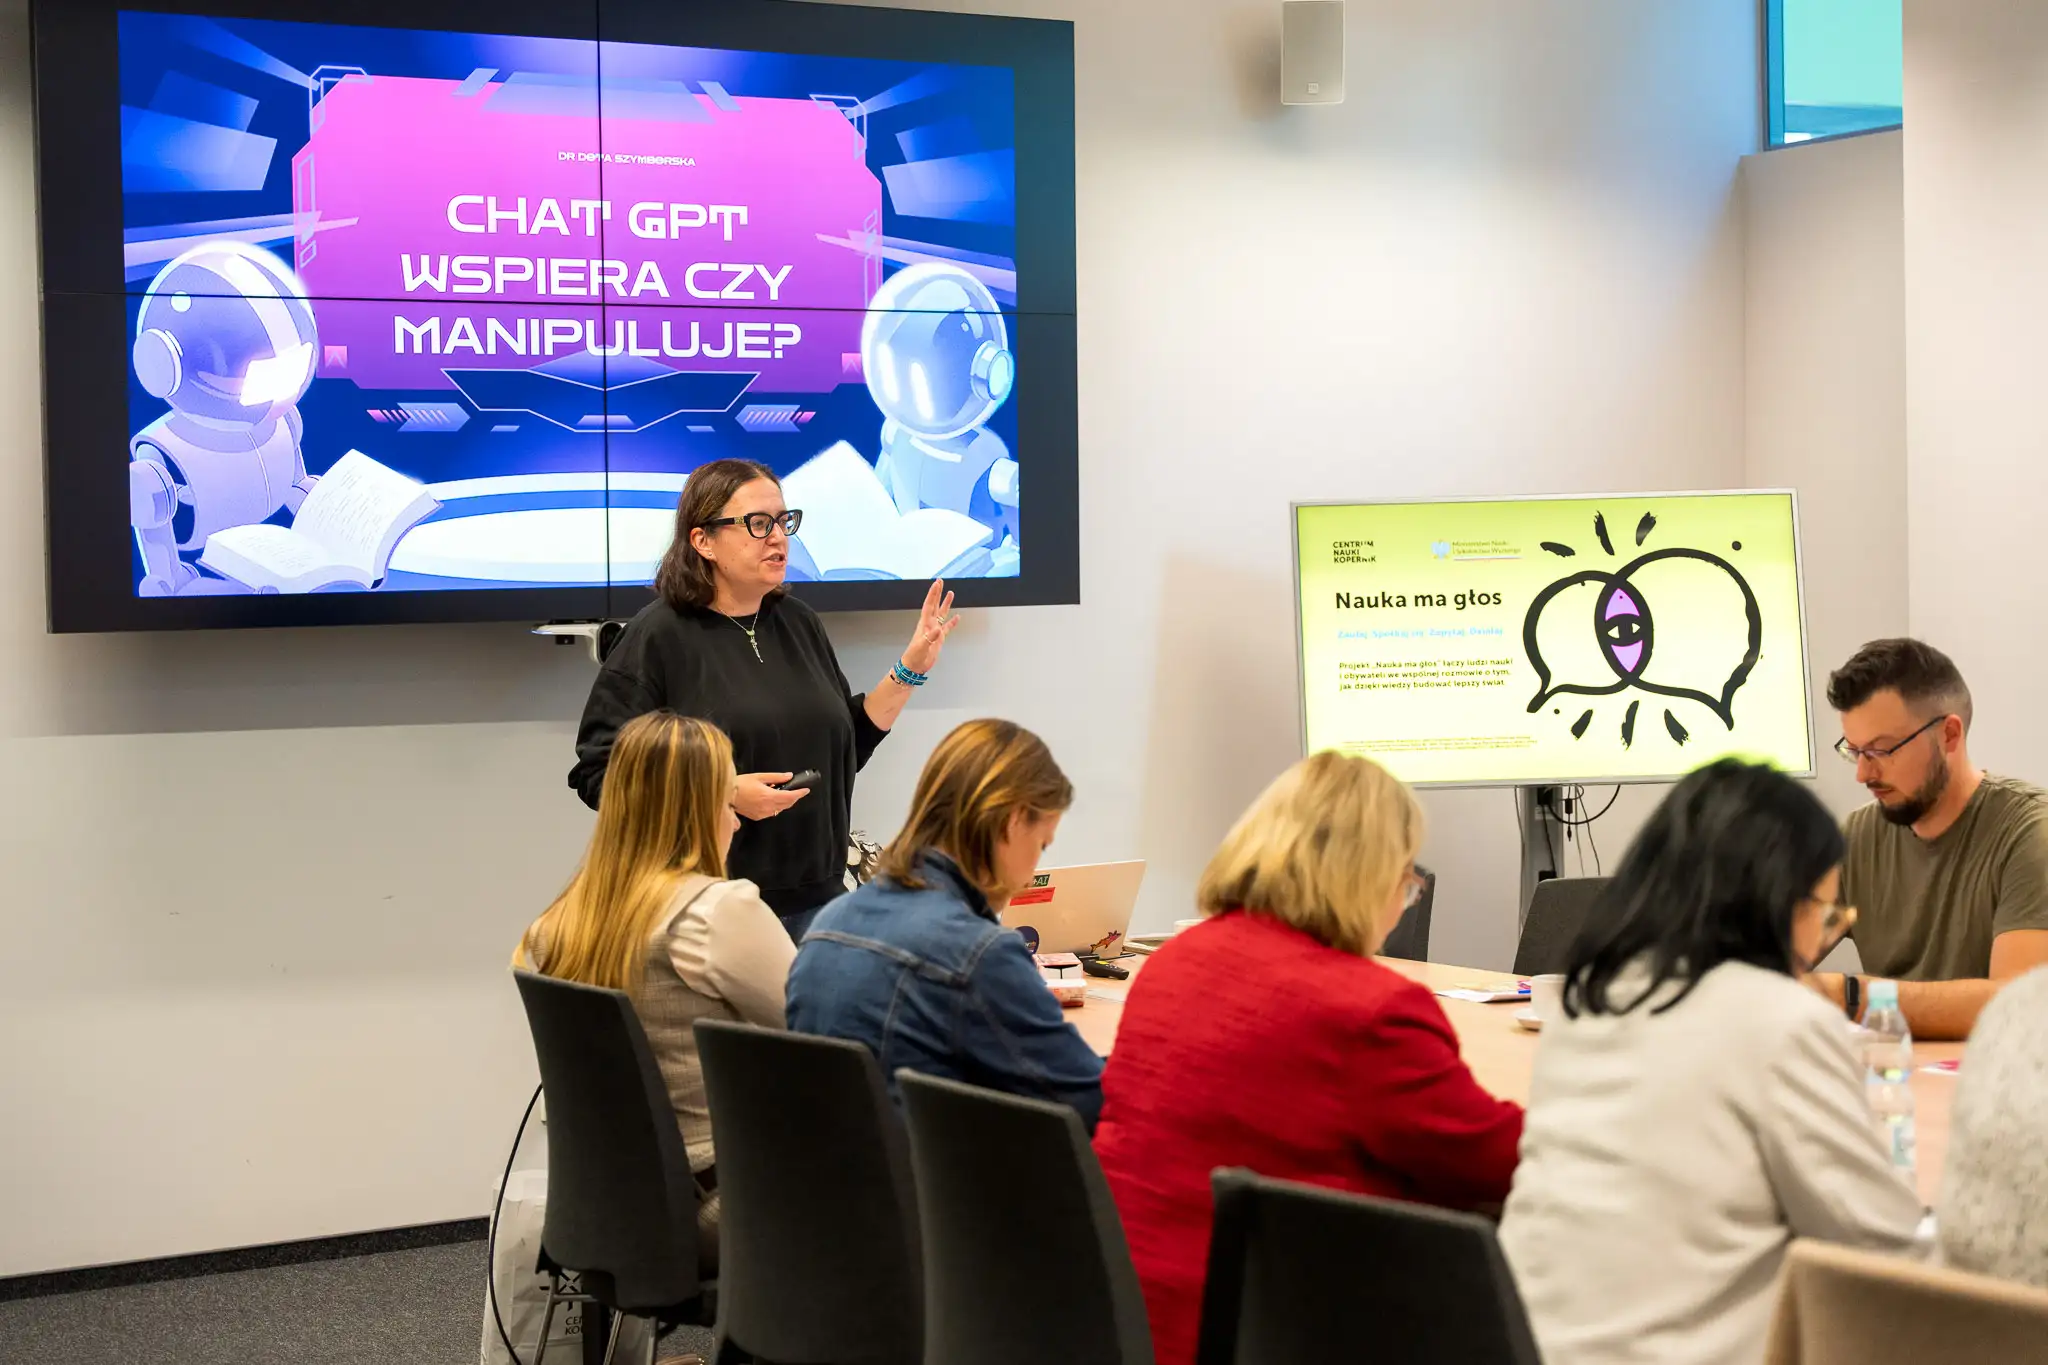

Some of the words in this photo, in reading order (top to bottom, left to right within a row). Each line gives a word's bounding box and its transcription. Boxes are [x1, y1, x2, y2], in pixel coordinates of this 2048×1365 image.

[558, 151, 575, 161] DR
[614, 154, 696, 167] SZYMBORSKA
[446, 194, 612, 237] CHAT
[627, 201, 748, 242] GPT
[400, 253, 671, 298] WSPIERA
[683, 262, 793, 301] CZY
[393, 315, 802, 359] MANIPULUJE?
[1335, 591, 1407, 609] Nauka
[1414, 592, 1447, 607] ma
[1453, 589, 1502, 610] głos
[1339, 662, 1370, 670] Projekt
[1344, 671, 1386, 680] obywateli
[1402, 670, 1439, 679] wspólnej
[1441, 669, 1483, 677] rozmowie
[1339, 683, 1352, 691] jak
[1354, 682, 1380, 690] dzięki
[1382, 681, 1411, 689] wiedzy
[1413, 679, 1451, 689] budować
[1453, 680, 1480, 688] lepszy
